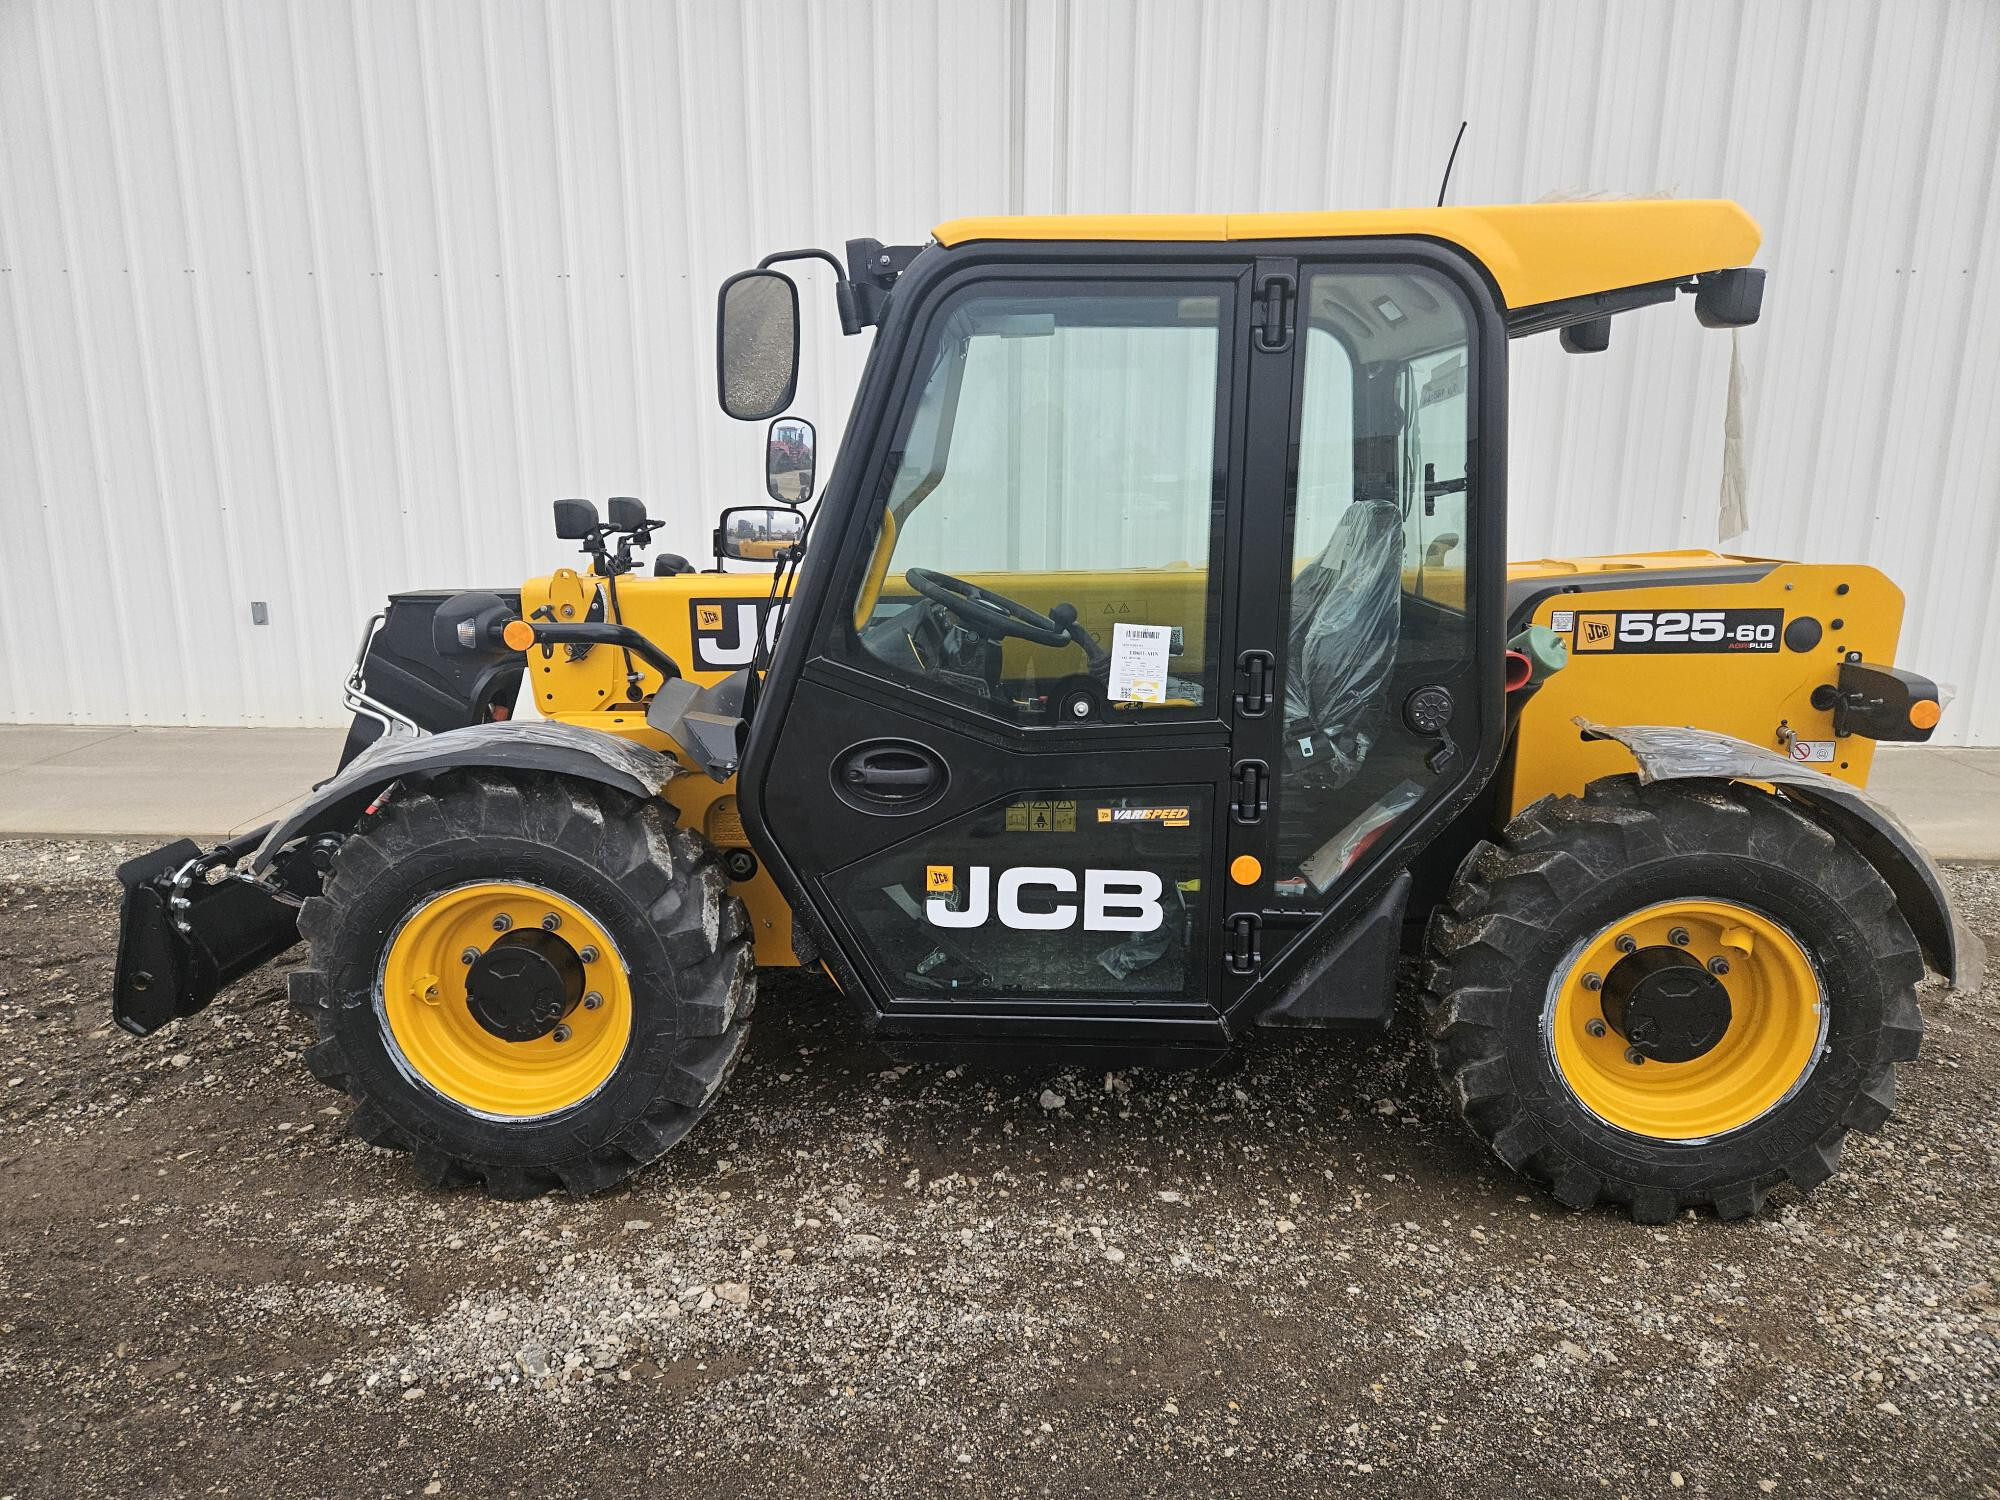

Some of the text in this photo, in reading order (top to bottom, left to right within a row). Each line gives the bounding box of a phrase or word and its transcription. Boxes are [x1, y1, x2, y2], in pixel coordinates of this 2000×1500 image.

[1588, 623, 1609, 641] JCB
[1618, 612, 1775, 642] 525-60
[1114, 808, 1188, 820] VARISPEED
[933, 872, 949, 884] JCB
[926, 866, 1164, 932] JCB
